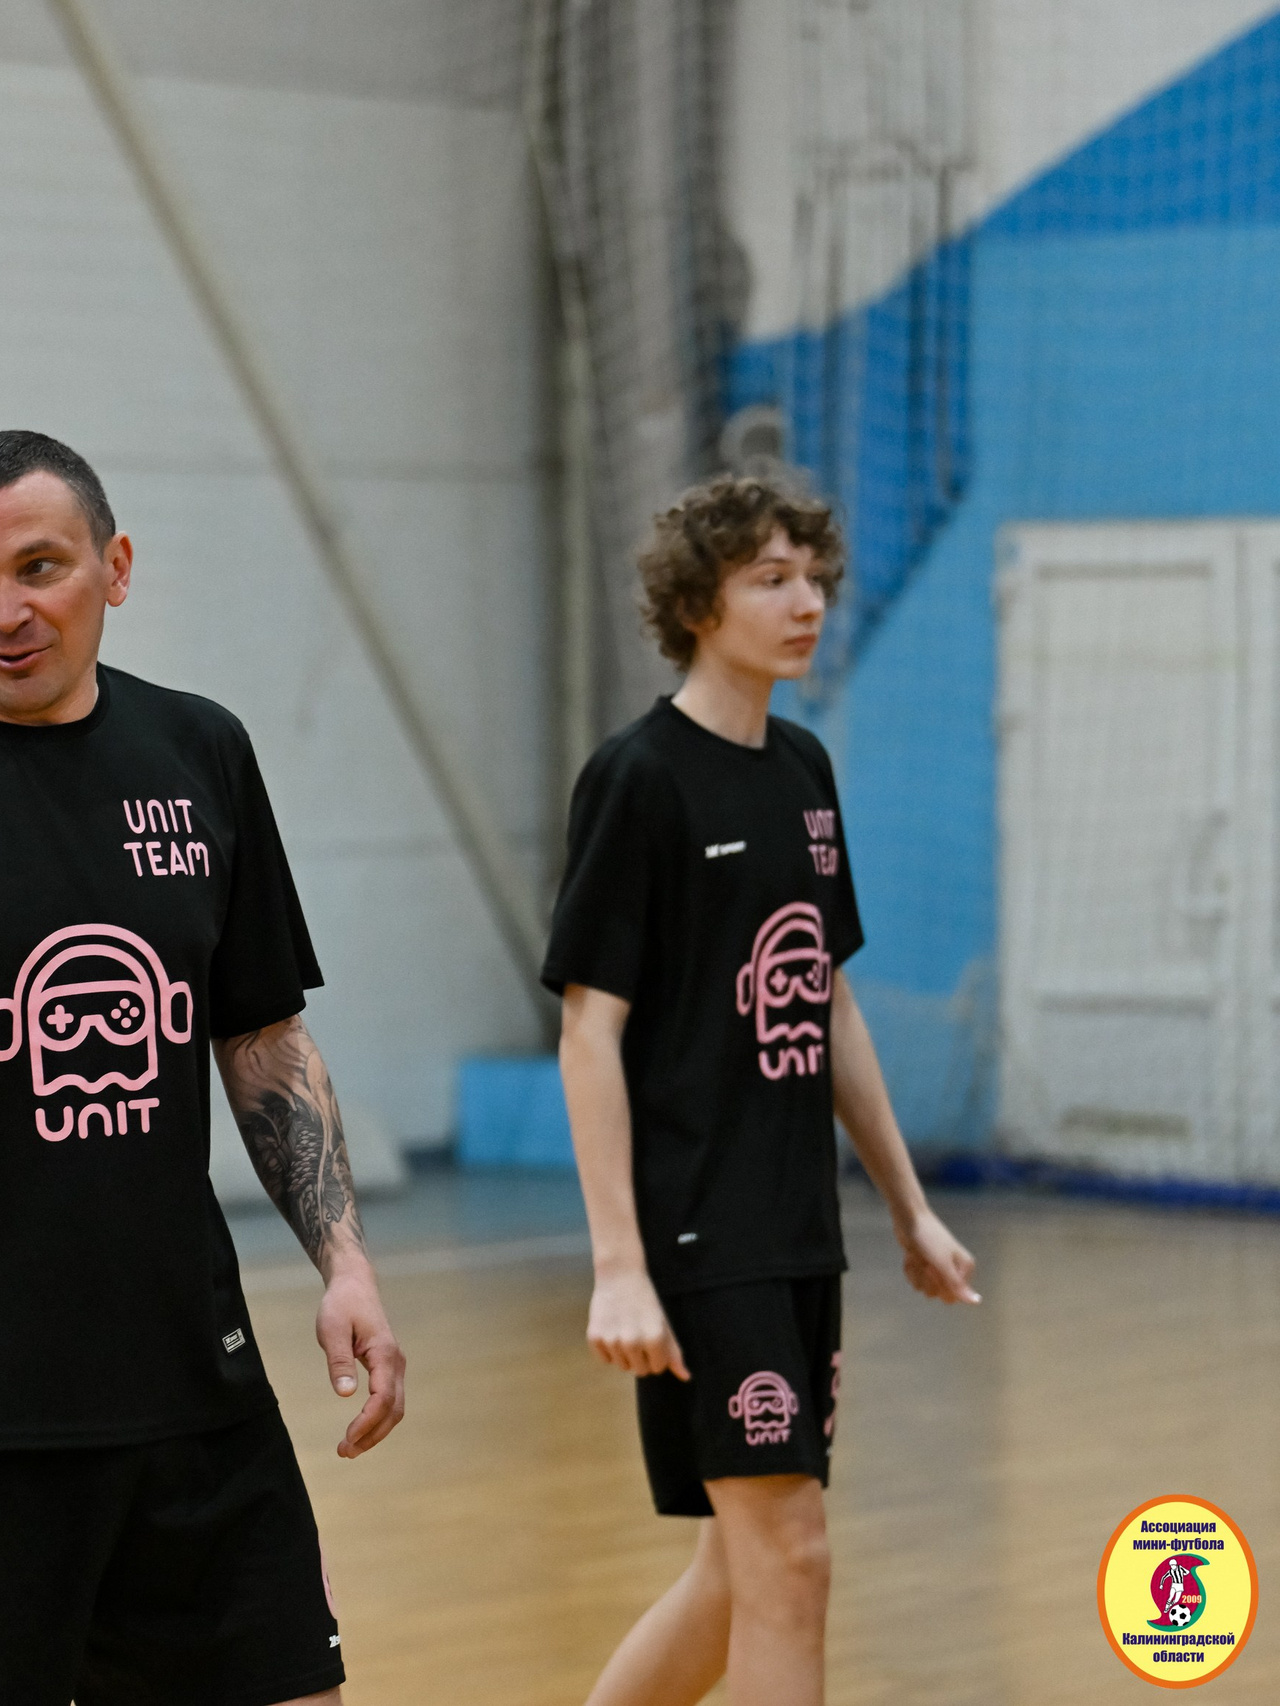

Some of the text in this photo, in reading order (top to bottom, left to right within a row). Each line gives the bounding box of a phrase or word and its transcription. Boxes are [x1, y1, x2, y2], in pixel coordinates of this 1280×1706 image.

[123, 799, 192, 834] UNIT
[123, 841, 210, 877] TEAM
[35, 1097, 160, 1142] UNIT
